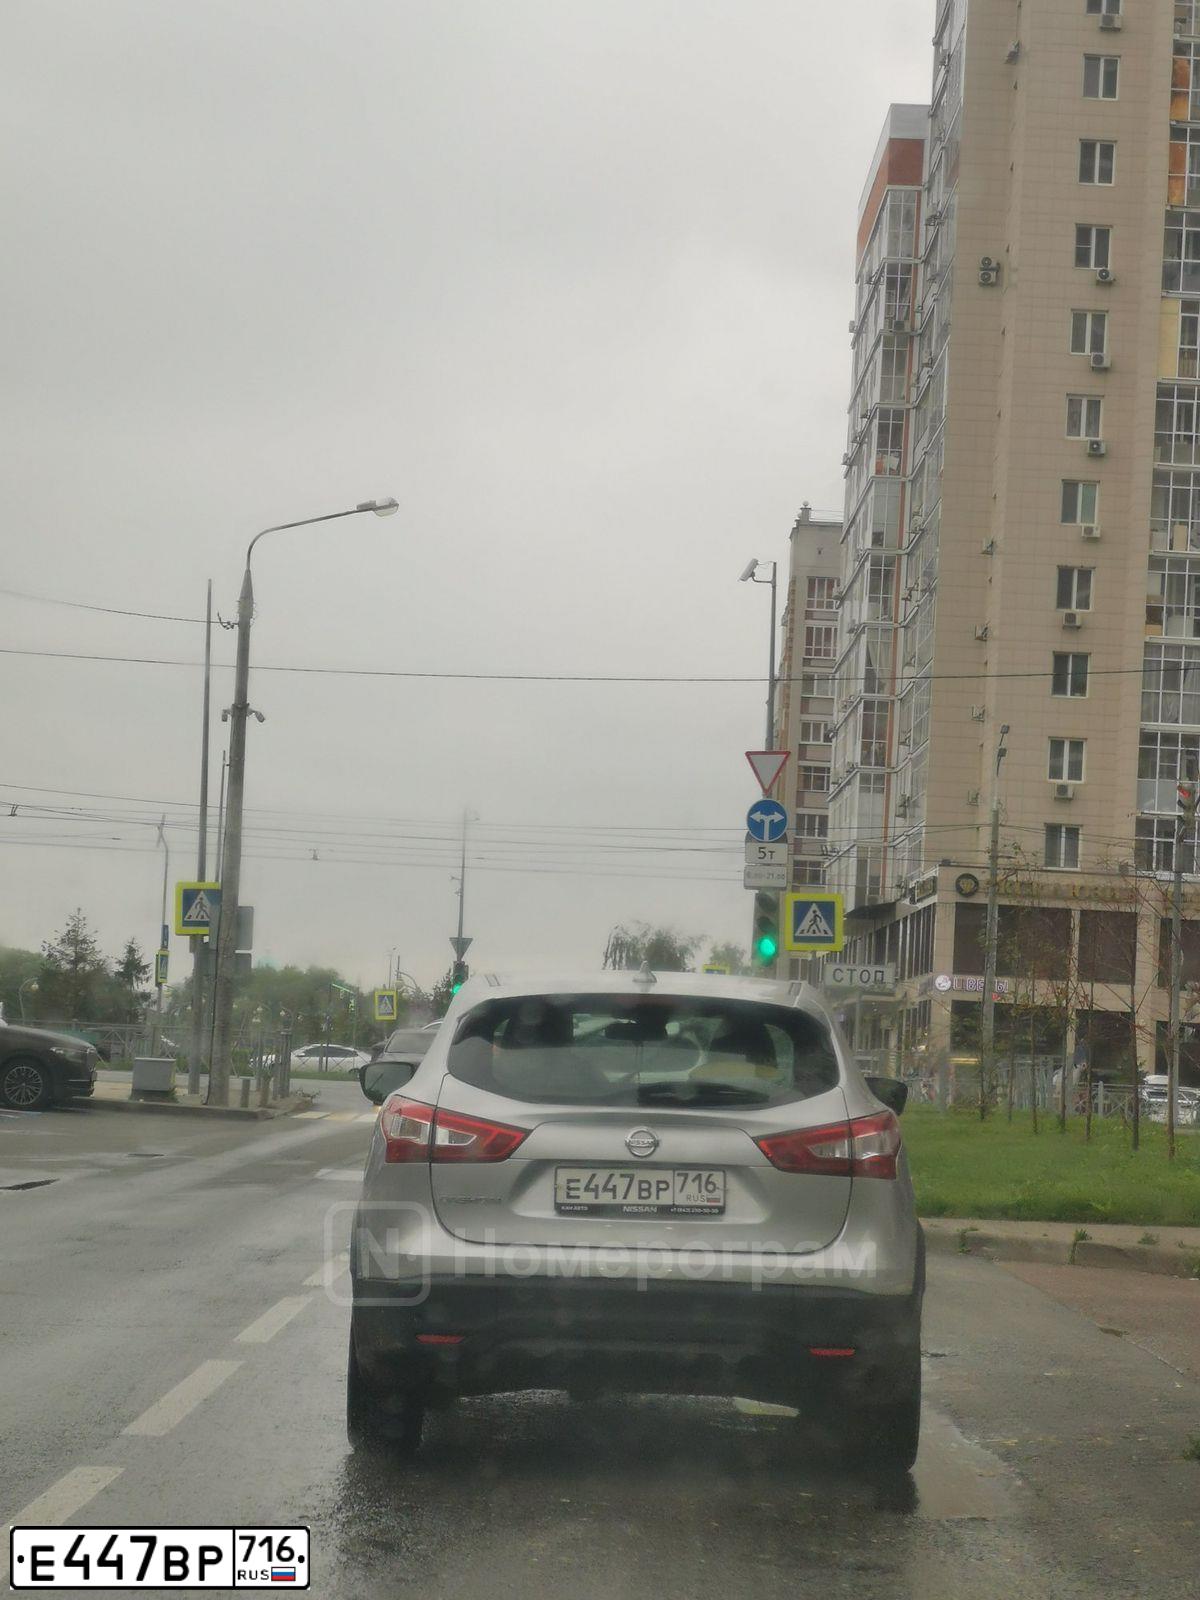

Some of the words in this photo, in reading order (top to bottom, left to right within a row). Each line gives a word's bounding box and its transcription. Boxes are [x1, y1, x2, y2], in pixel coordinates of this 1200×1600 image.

[832, 967, 886, 985] СТОП
[952, 977, 1009, 993] ЦВЕЫ
[676, 1172, 717, 1194] 716
[686, 1194, 706, 1203] RUS
[622, 1205, 658, 1213] NISSAN
